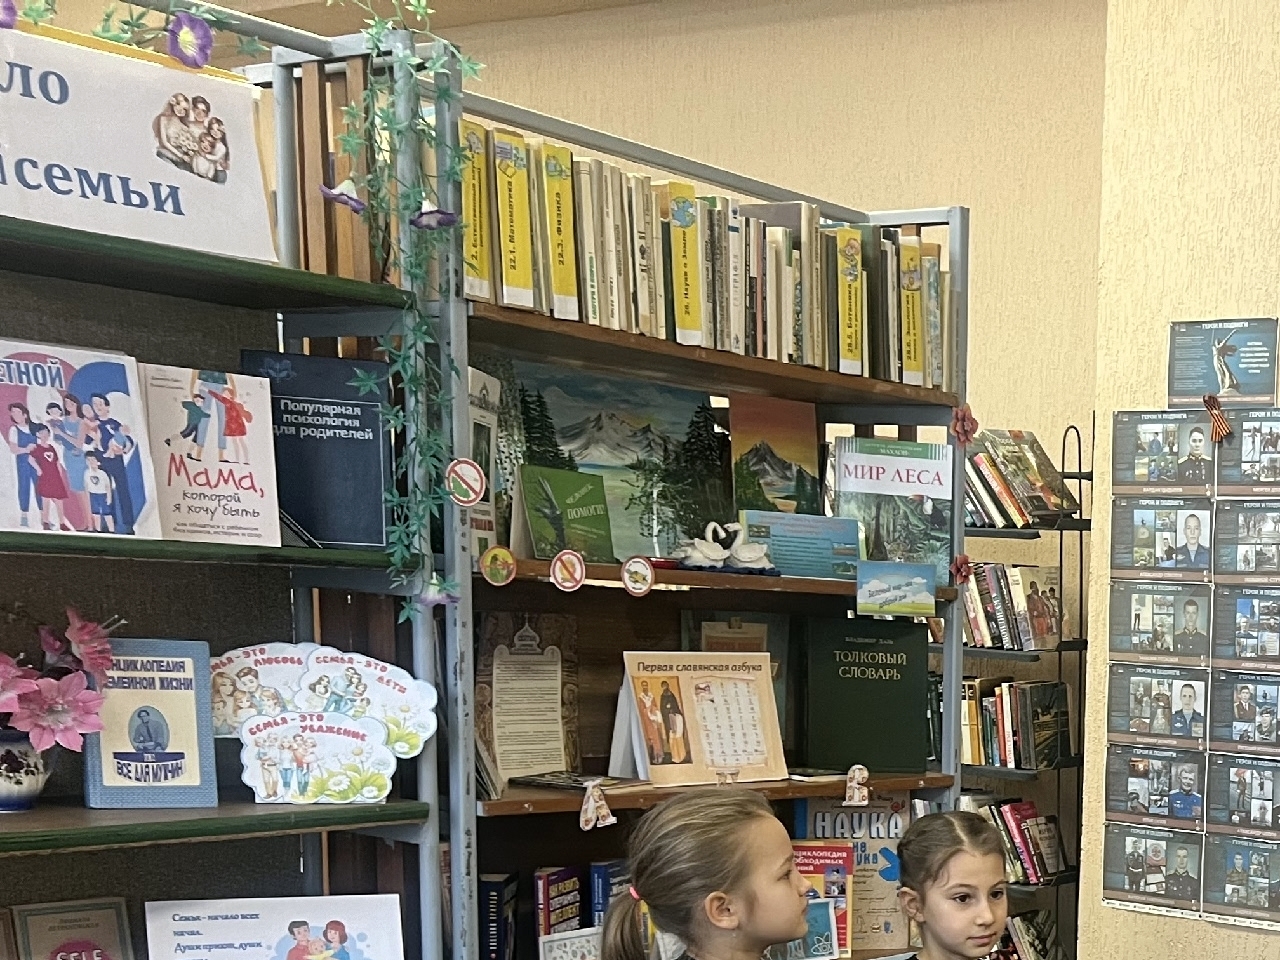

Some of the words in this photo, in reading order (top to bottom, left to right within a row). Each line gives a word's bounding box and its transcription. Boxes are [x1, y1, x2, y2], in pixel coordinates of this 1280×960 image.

[506, 180, 515, 244] Математика
[554, 191, 563, 236] Физика
[844, 283, 852, 328] Ботаника
[281, 400, 361, 417] Популярная
[283, 413, 360, 427] психология
[300, 426, 373, 440] родителей
[168, 453, 264, 498] Мама,
[842, 462, 886, 482] МИР
[890, 464, 944, 487] ЛЕСА
[182, 490, 241, 508] которой
[172, 504, 181, 513] я
[187, 504, 218, 521] хочу
[222, 503, 261, 518] быть
[211, 657, 234, 672] МЬЯ
[242, 648, 266, 659] ЭТО
[253, 657, 304, 667] ЛЮБОВЬ
[315, 656, 354, 665] СЕМЬЯ
[364, 661, 388, 673] ЭТО
[833, 650, 907, 666] ТОЛКОВЫЙ
[637, 662, 674, 673] Первая
[675, 663, 730, 672] славянская
[731, 663, 762, 674] азбука
[838, 667, 901, 680] СЛОВАРЬ
[107, 676, 156, 690] ЕМЕЙНОЙ
[159, 676, 193, 690] ЖИЗНИ
[248, 717, 288, 735] СЕМЬЯ
[299, 714, 324, 722] ЭТО
[299, 725, 367, 742] УВАЖЕНИЕ
[116, 762, 132, 780] ВСЕ
[815, 811, 903, 839] НАУКА
[794, 850, 847, 858] ЦИКЛОПЕДИЯ
[856, 852, 878, 866] ука
